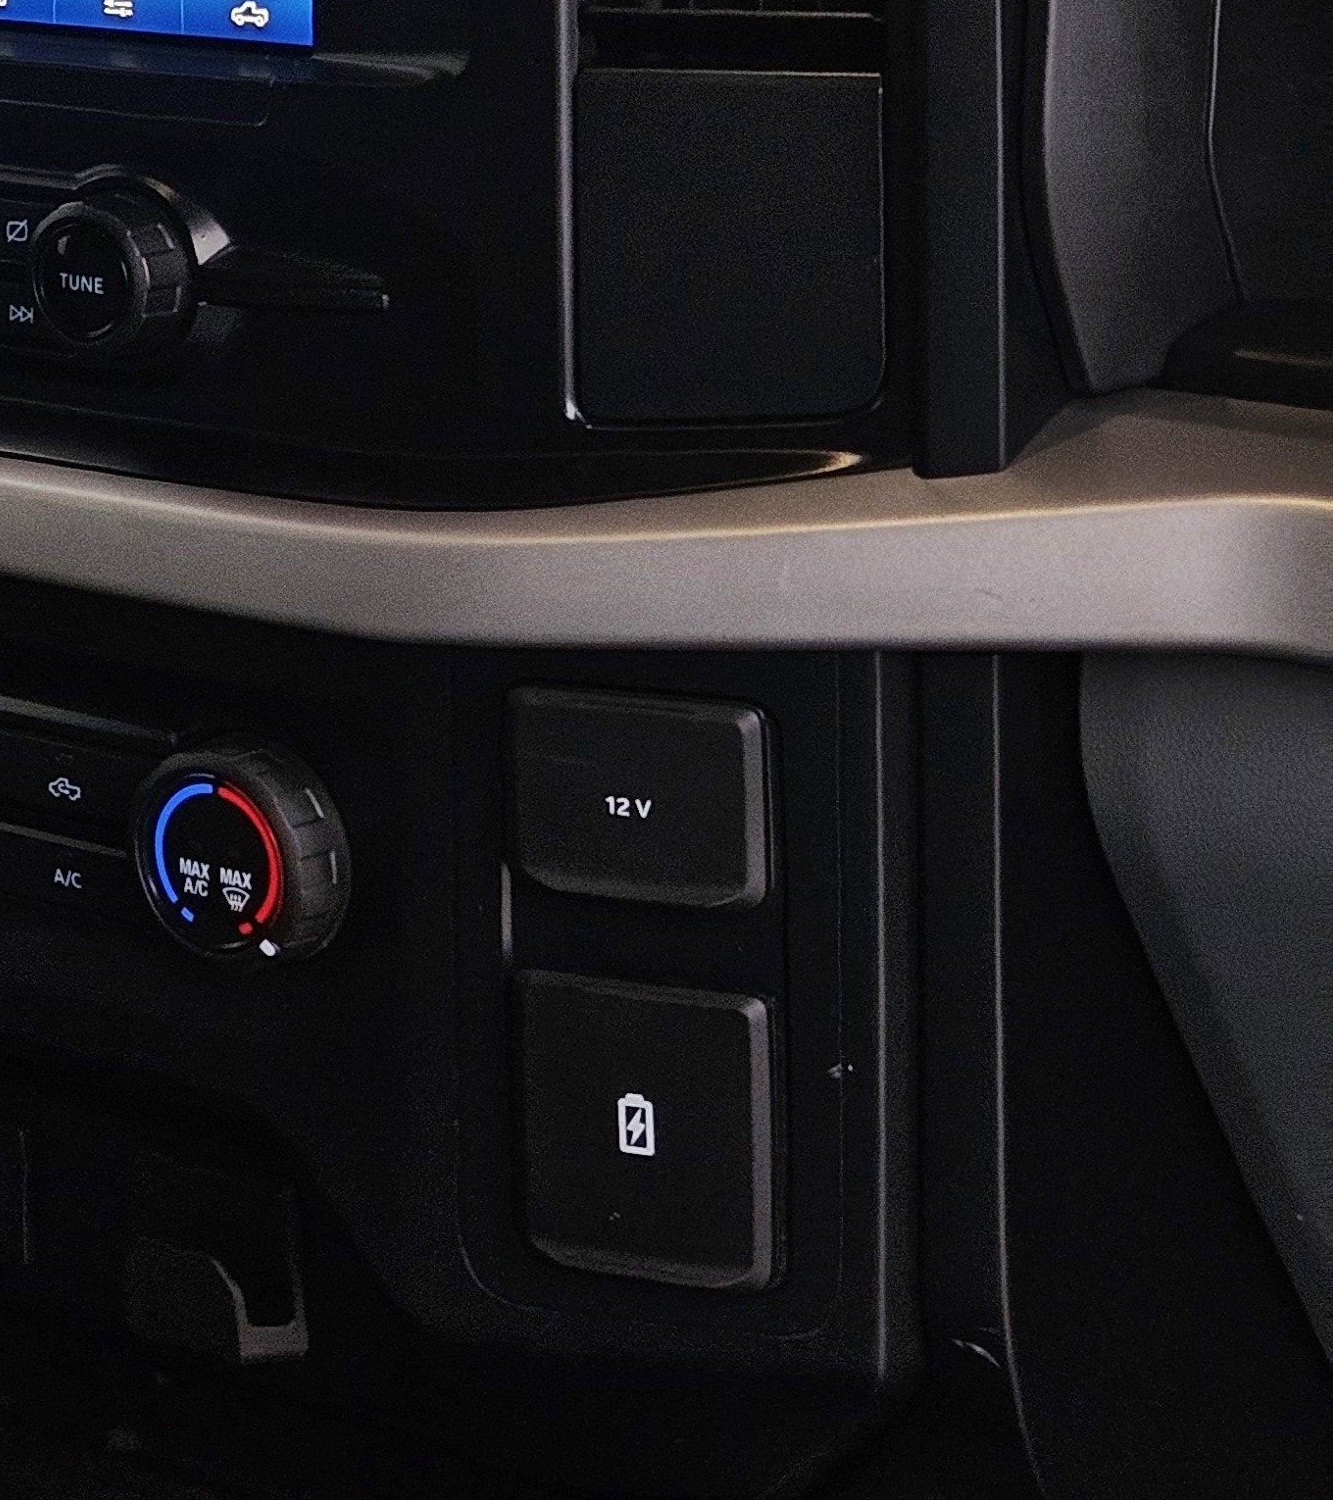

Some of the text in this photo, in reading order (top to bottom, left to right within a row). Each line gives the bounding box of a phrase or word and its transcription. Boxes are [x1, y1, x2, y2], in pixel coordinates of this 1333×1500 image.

[59, 273, 104, 296] TUNE
[54, 868, 83, 889] A/C
[179, 857, 210, 880] MAX
[220, 866, 252, 890] MAX
[184, 877, 208, 897] A/C
